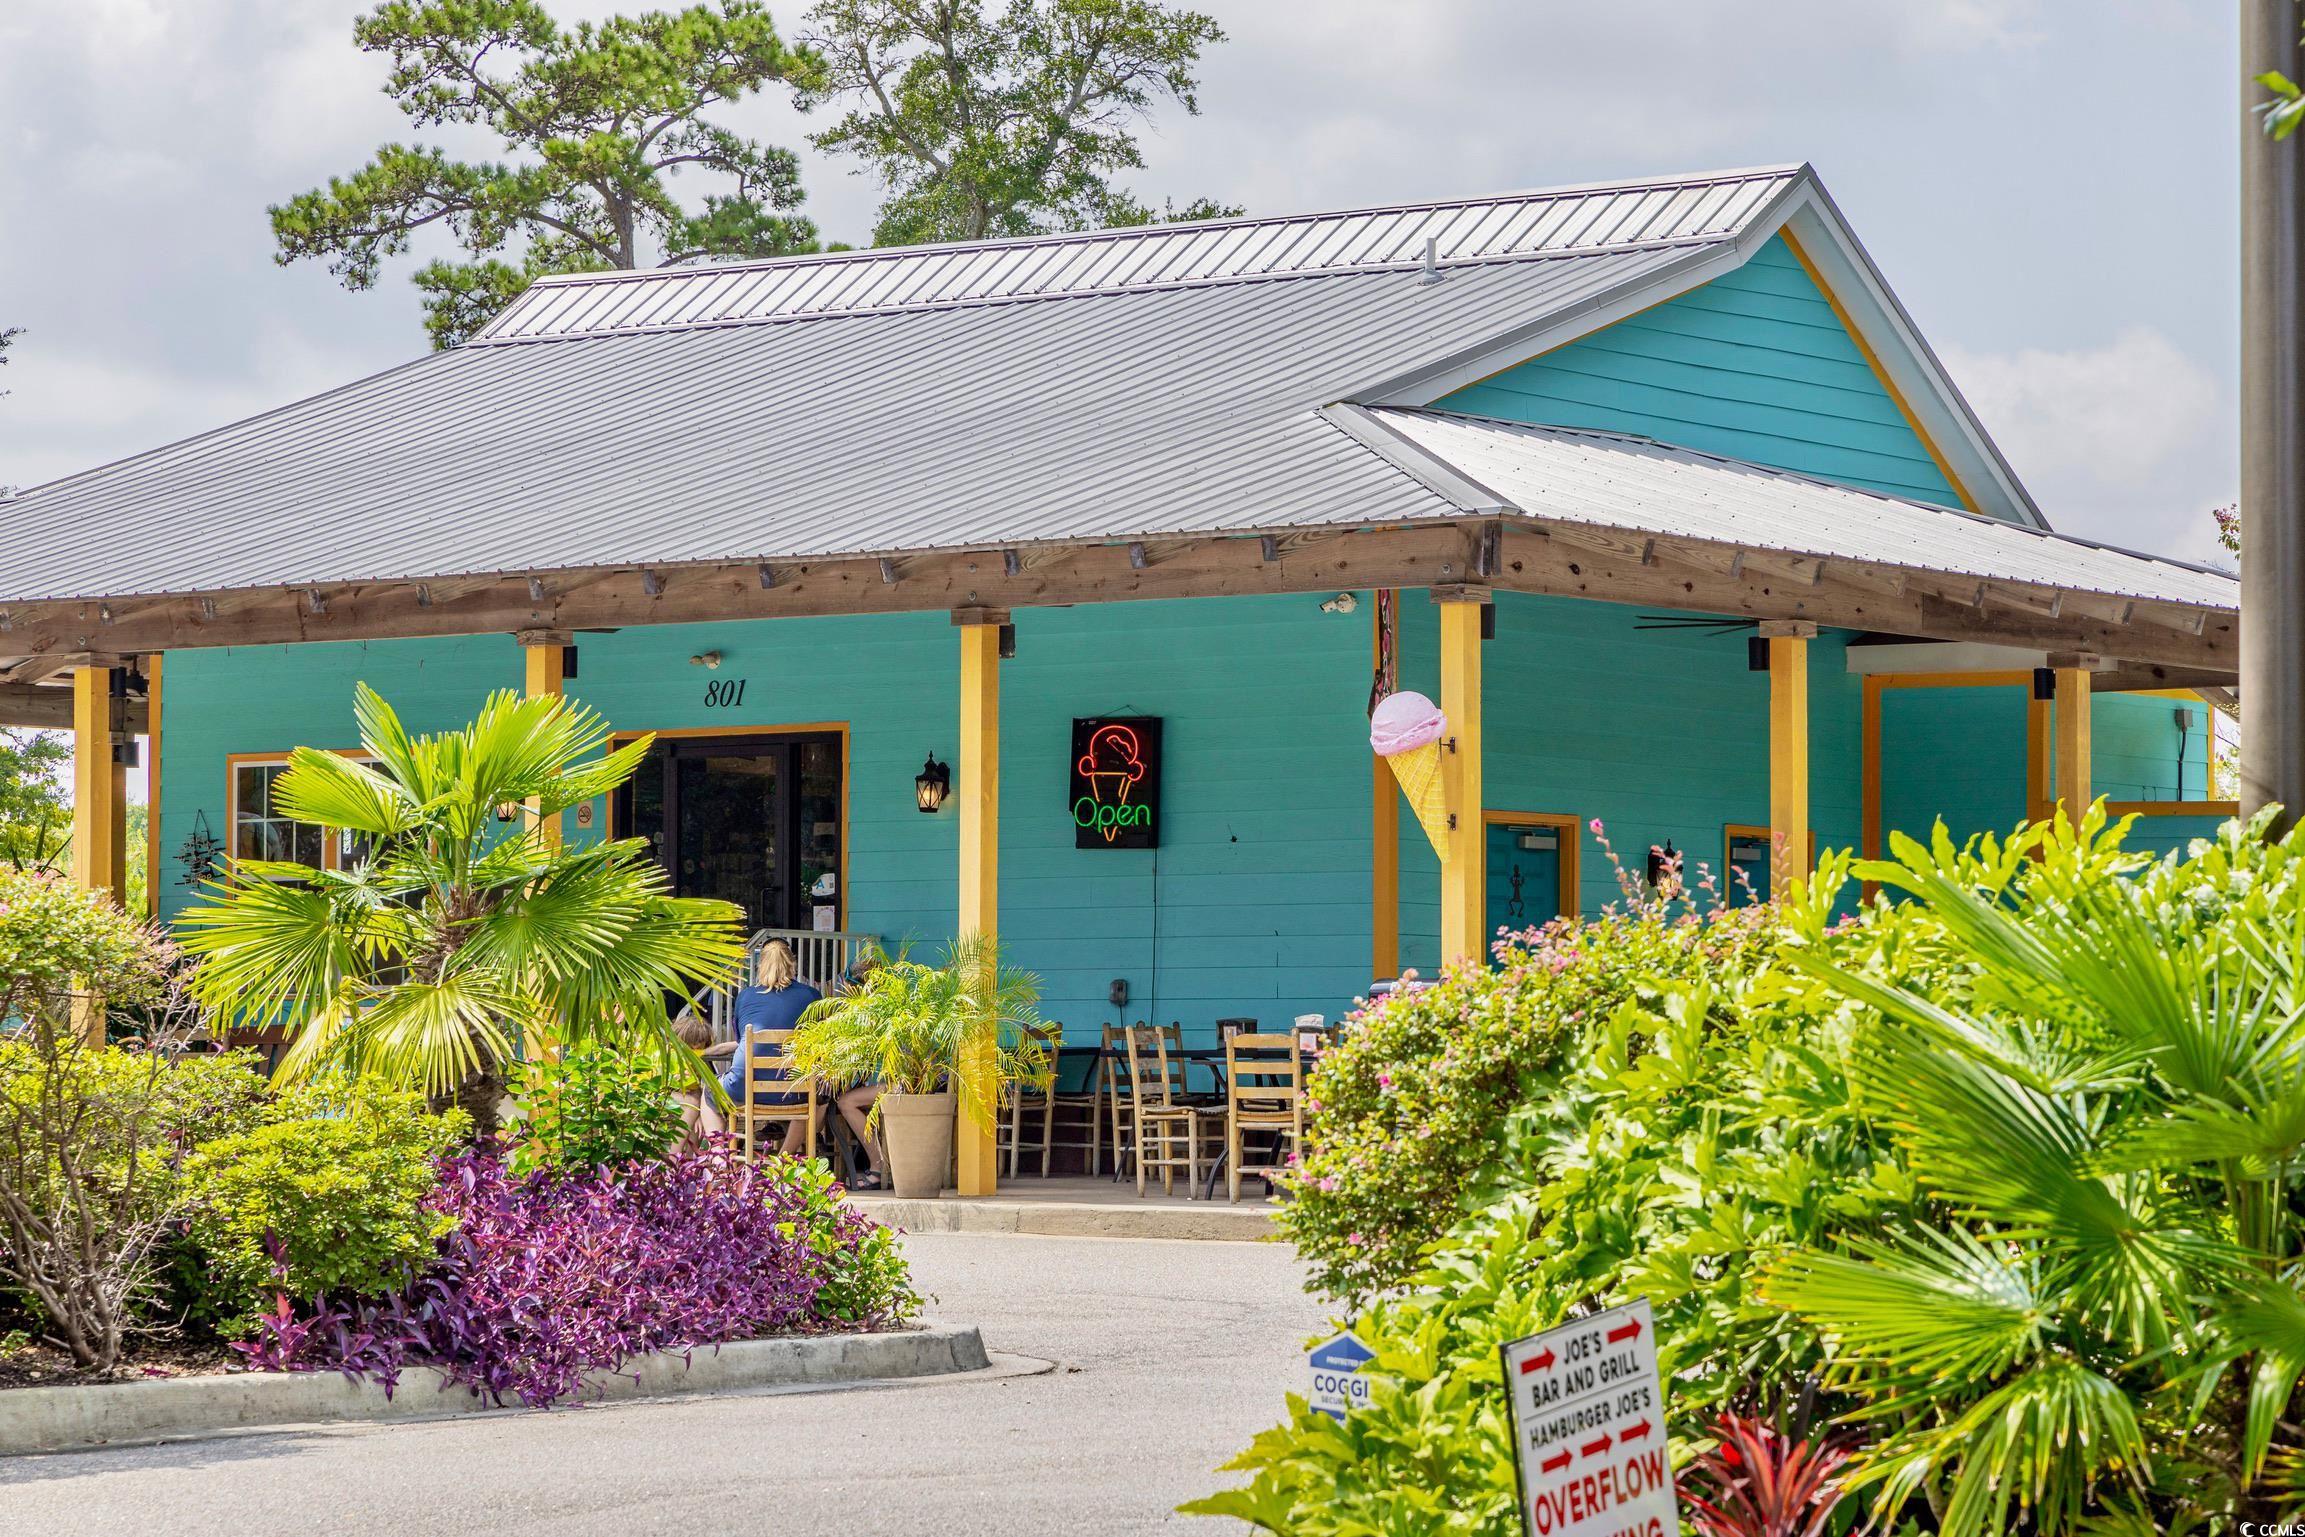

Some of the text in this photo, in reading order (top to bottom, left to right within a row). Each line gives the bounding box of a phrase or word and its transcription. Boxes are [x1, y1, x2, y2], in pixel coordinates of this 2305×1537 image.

[704, 679, 746, 707] 801
[1074, 796, 1151, 833] Open
[1563, 1331, 1602, 1364] JOE'S
[1532, 1350, 1640, 1408] BAR AND GRILL
[1530, 1386, 1651, 1450] HAMBURGER JOE'S
[1535, 1446, 1664, 1536] OVERFLOW
